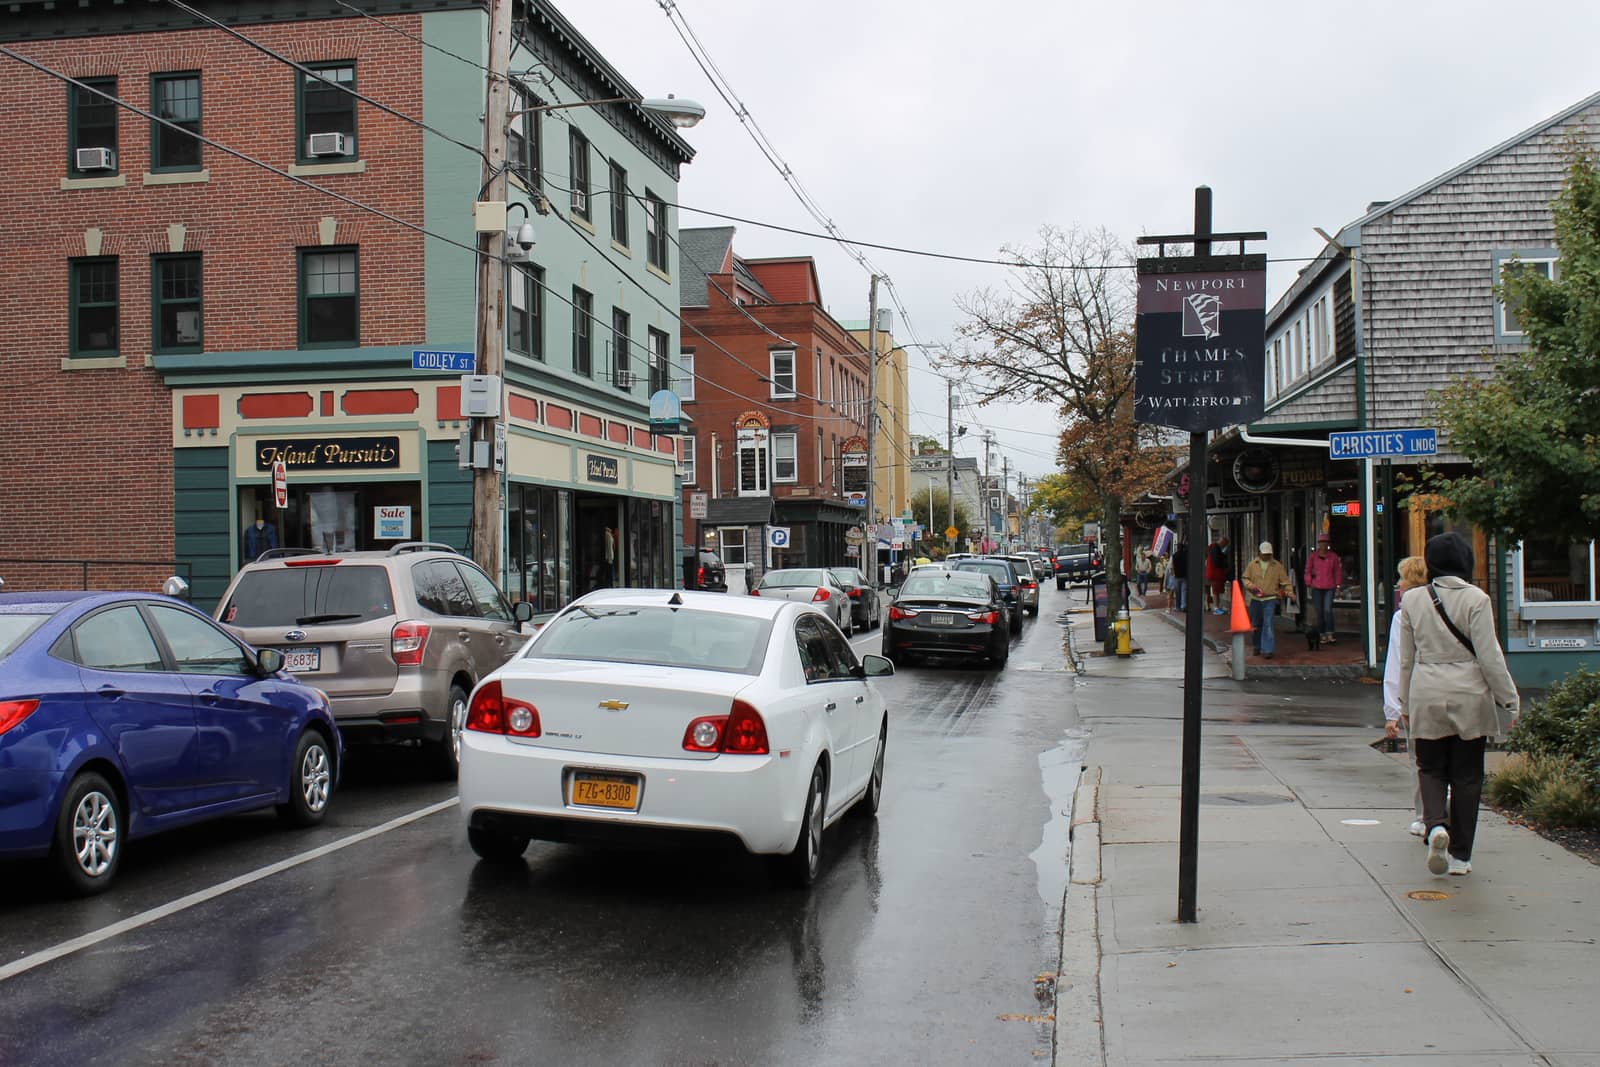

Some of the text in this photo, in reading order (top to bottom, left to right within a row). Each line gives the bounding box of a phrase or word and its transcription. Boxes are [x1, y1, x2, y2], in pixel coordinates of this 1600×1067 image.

[1155, 277, 1248, 292] NEWPORT
[418, 352, 469, 369] GIDLEY ST
[1331, 433, 1436, 456] CHRISTIE'S LNDG
[260, 443, 396, 467] Island Pursuit
[380, 507, 406, 519] Sale
